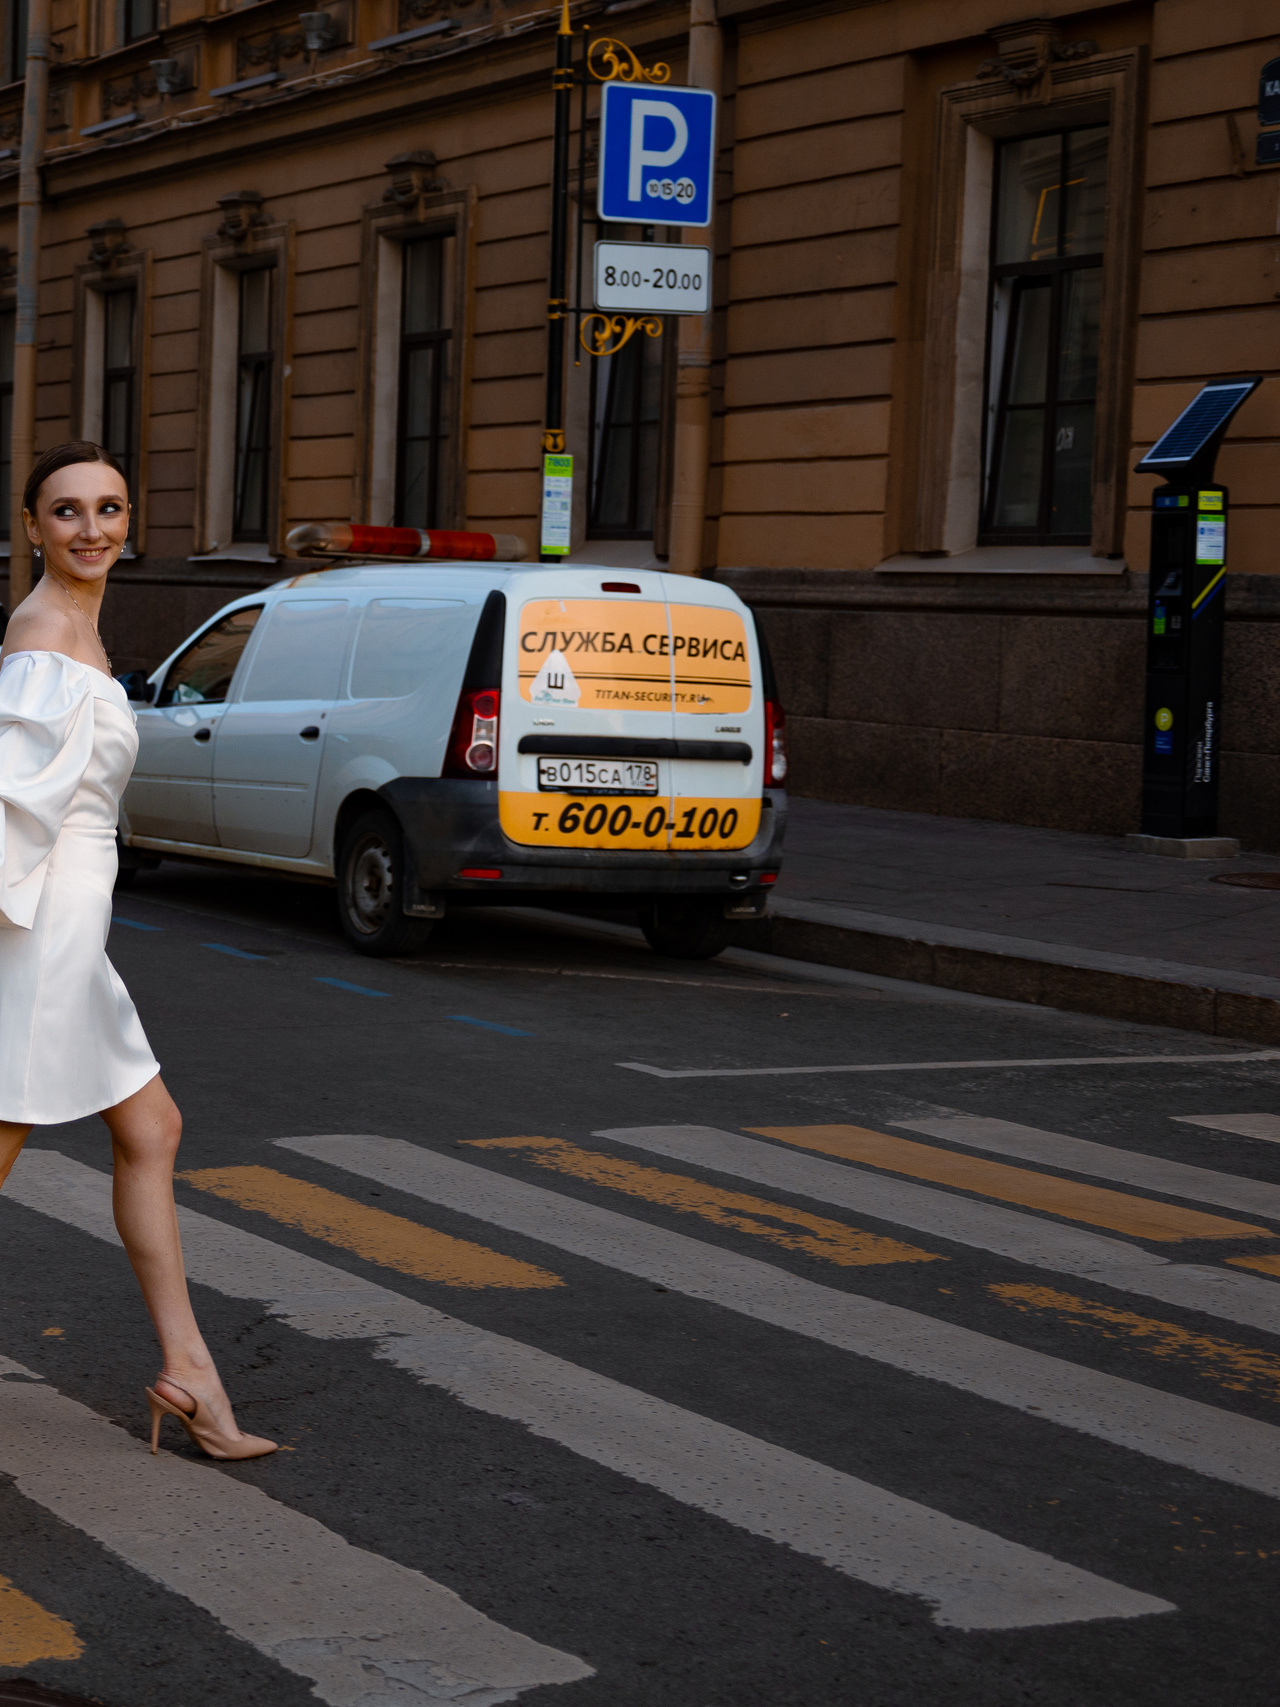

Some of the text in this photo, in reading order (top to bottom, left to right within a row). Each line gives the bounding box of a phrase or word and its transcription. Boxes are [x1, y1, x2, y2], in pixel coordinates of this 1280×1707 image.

[627, 99, 688, 201] P
[649, 182, 694, 198] 10 15 20
[604, 265, 702, 290] 8.00-20.00
[521, 631, 746, 662] СЛУЖБА СЕРВИСА
[547, 672, 565, 690] Ш
[625, 765, 652, 781] 178
[558, 802, 738, 839] 600-0-100
